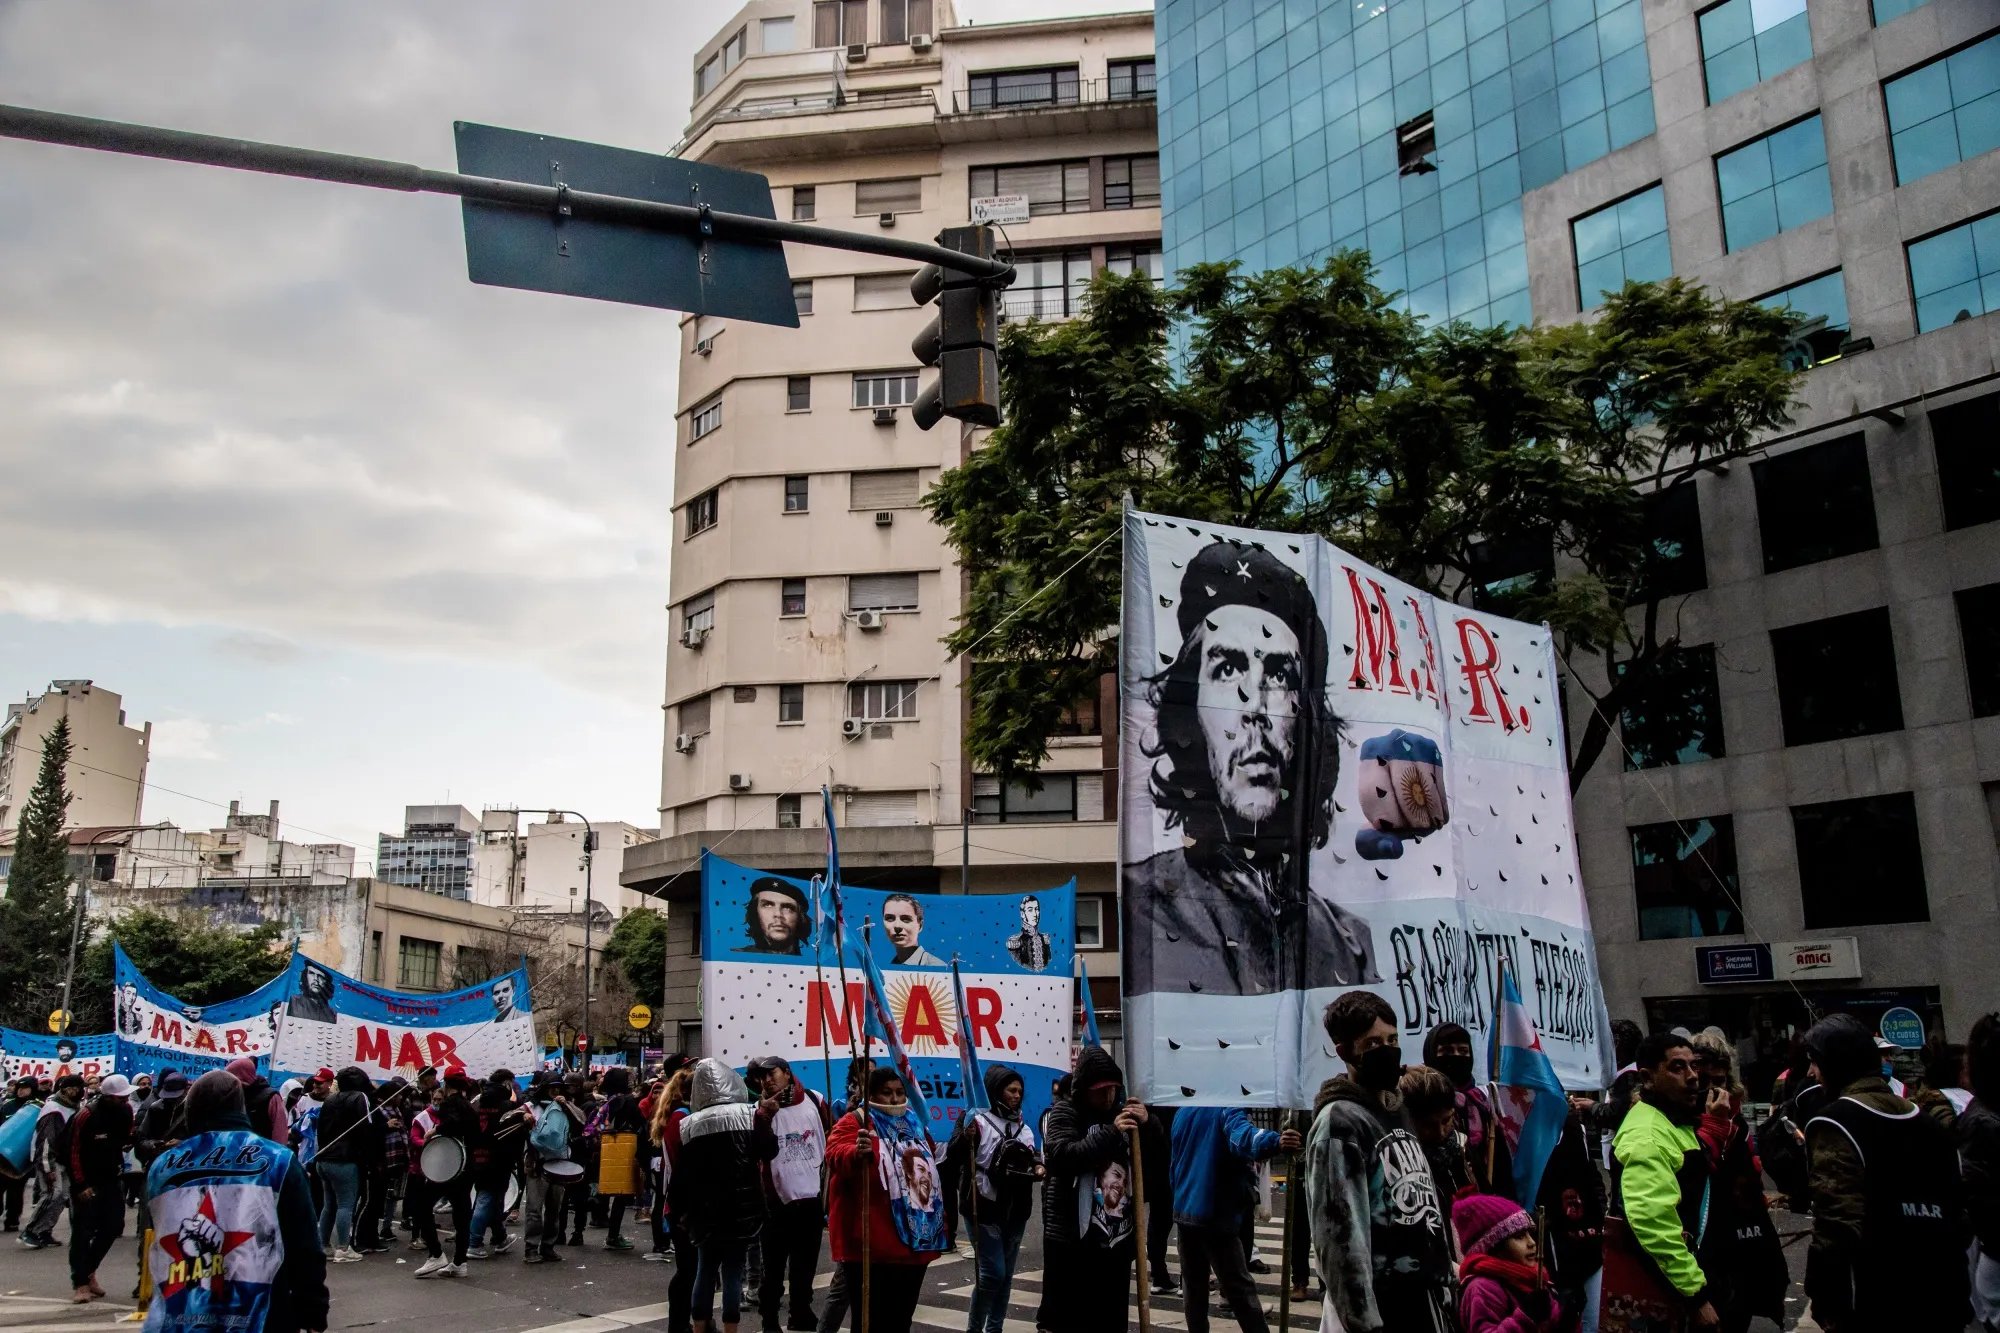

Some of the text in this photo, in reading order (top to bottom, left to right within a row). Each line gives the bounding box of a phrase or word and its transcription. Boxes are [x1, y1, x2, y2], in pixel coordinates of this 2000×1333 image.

[386, 1003, 439, 1017] MARTIN
[151, 1013, 259, 1054] M.A.R.
[1896, 1031, 1920, 1039] CUOTAS
[137, 1046, 190, 1063] PARQUE
[194, 1056, 221, 1067] SAN
[355, 1025, 467, 1071] MAR
[1901, 1202, 1943, 1219] M.A.R
